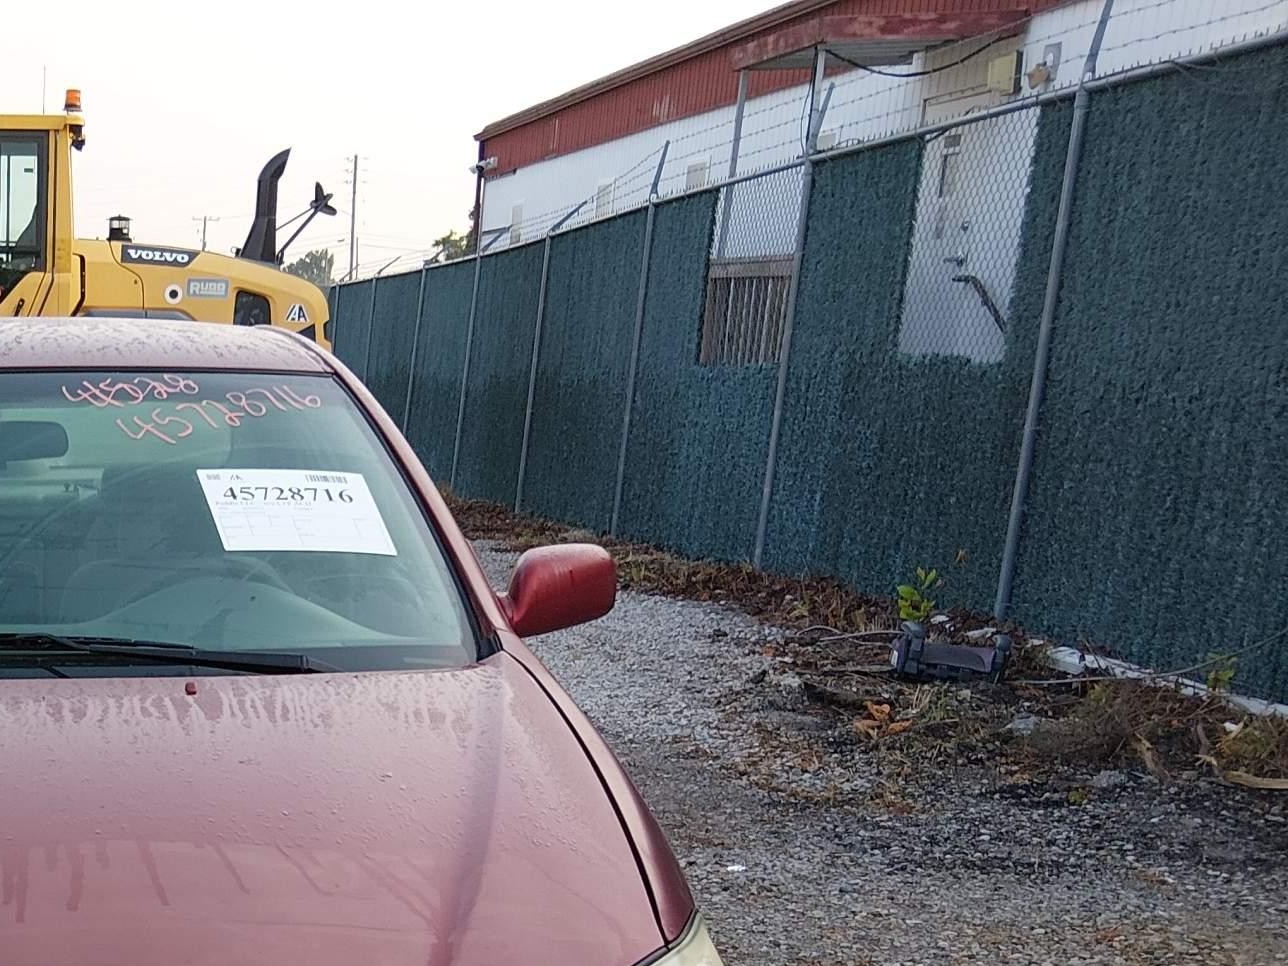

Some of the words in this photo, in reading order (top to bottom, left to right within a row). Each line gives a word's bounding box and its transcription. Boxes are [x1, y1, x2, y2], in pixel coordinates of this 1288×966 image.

[128, 248, 190, 264] VOLVO
[116, 385, 321, 444] 45728716
[223, 486, 353, 503] 45728716
